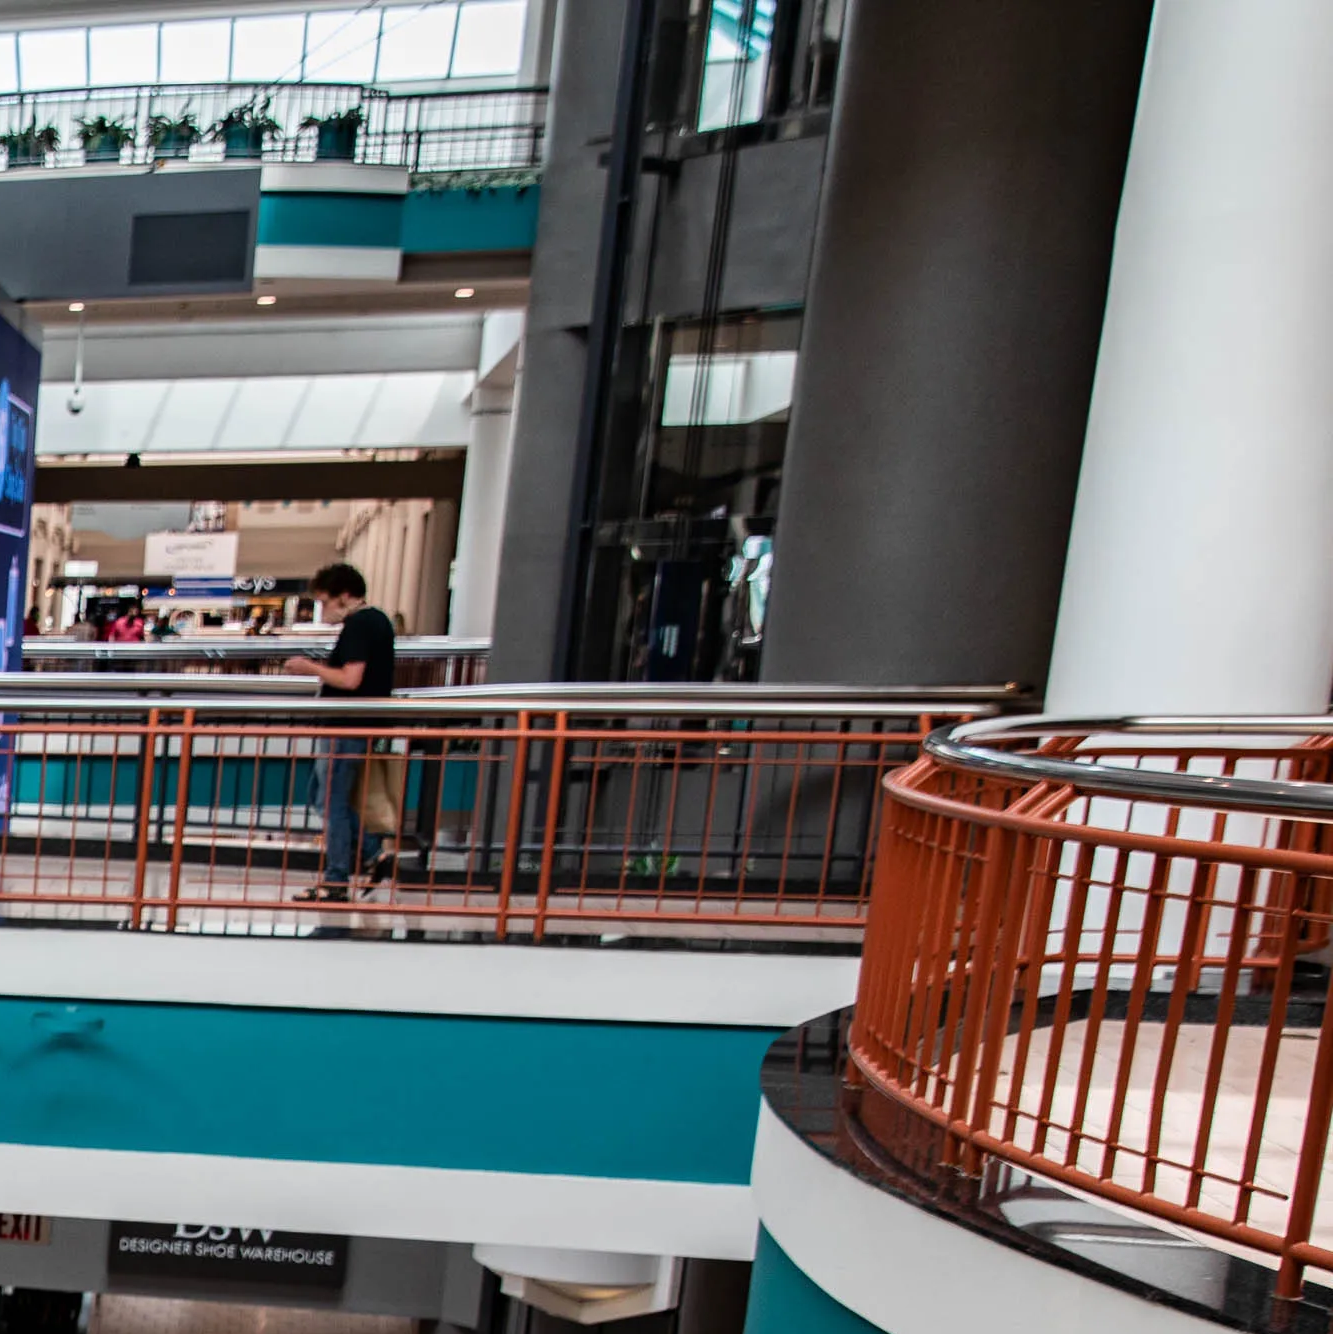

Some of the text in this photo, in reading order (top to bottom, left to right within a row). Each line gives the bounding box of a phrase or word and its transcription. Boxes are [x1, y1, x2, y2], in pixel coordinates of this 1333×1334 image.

[119, 1236, 334, 1266] DESIGNER SHOE WAREHOUSE
